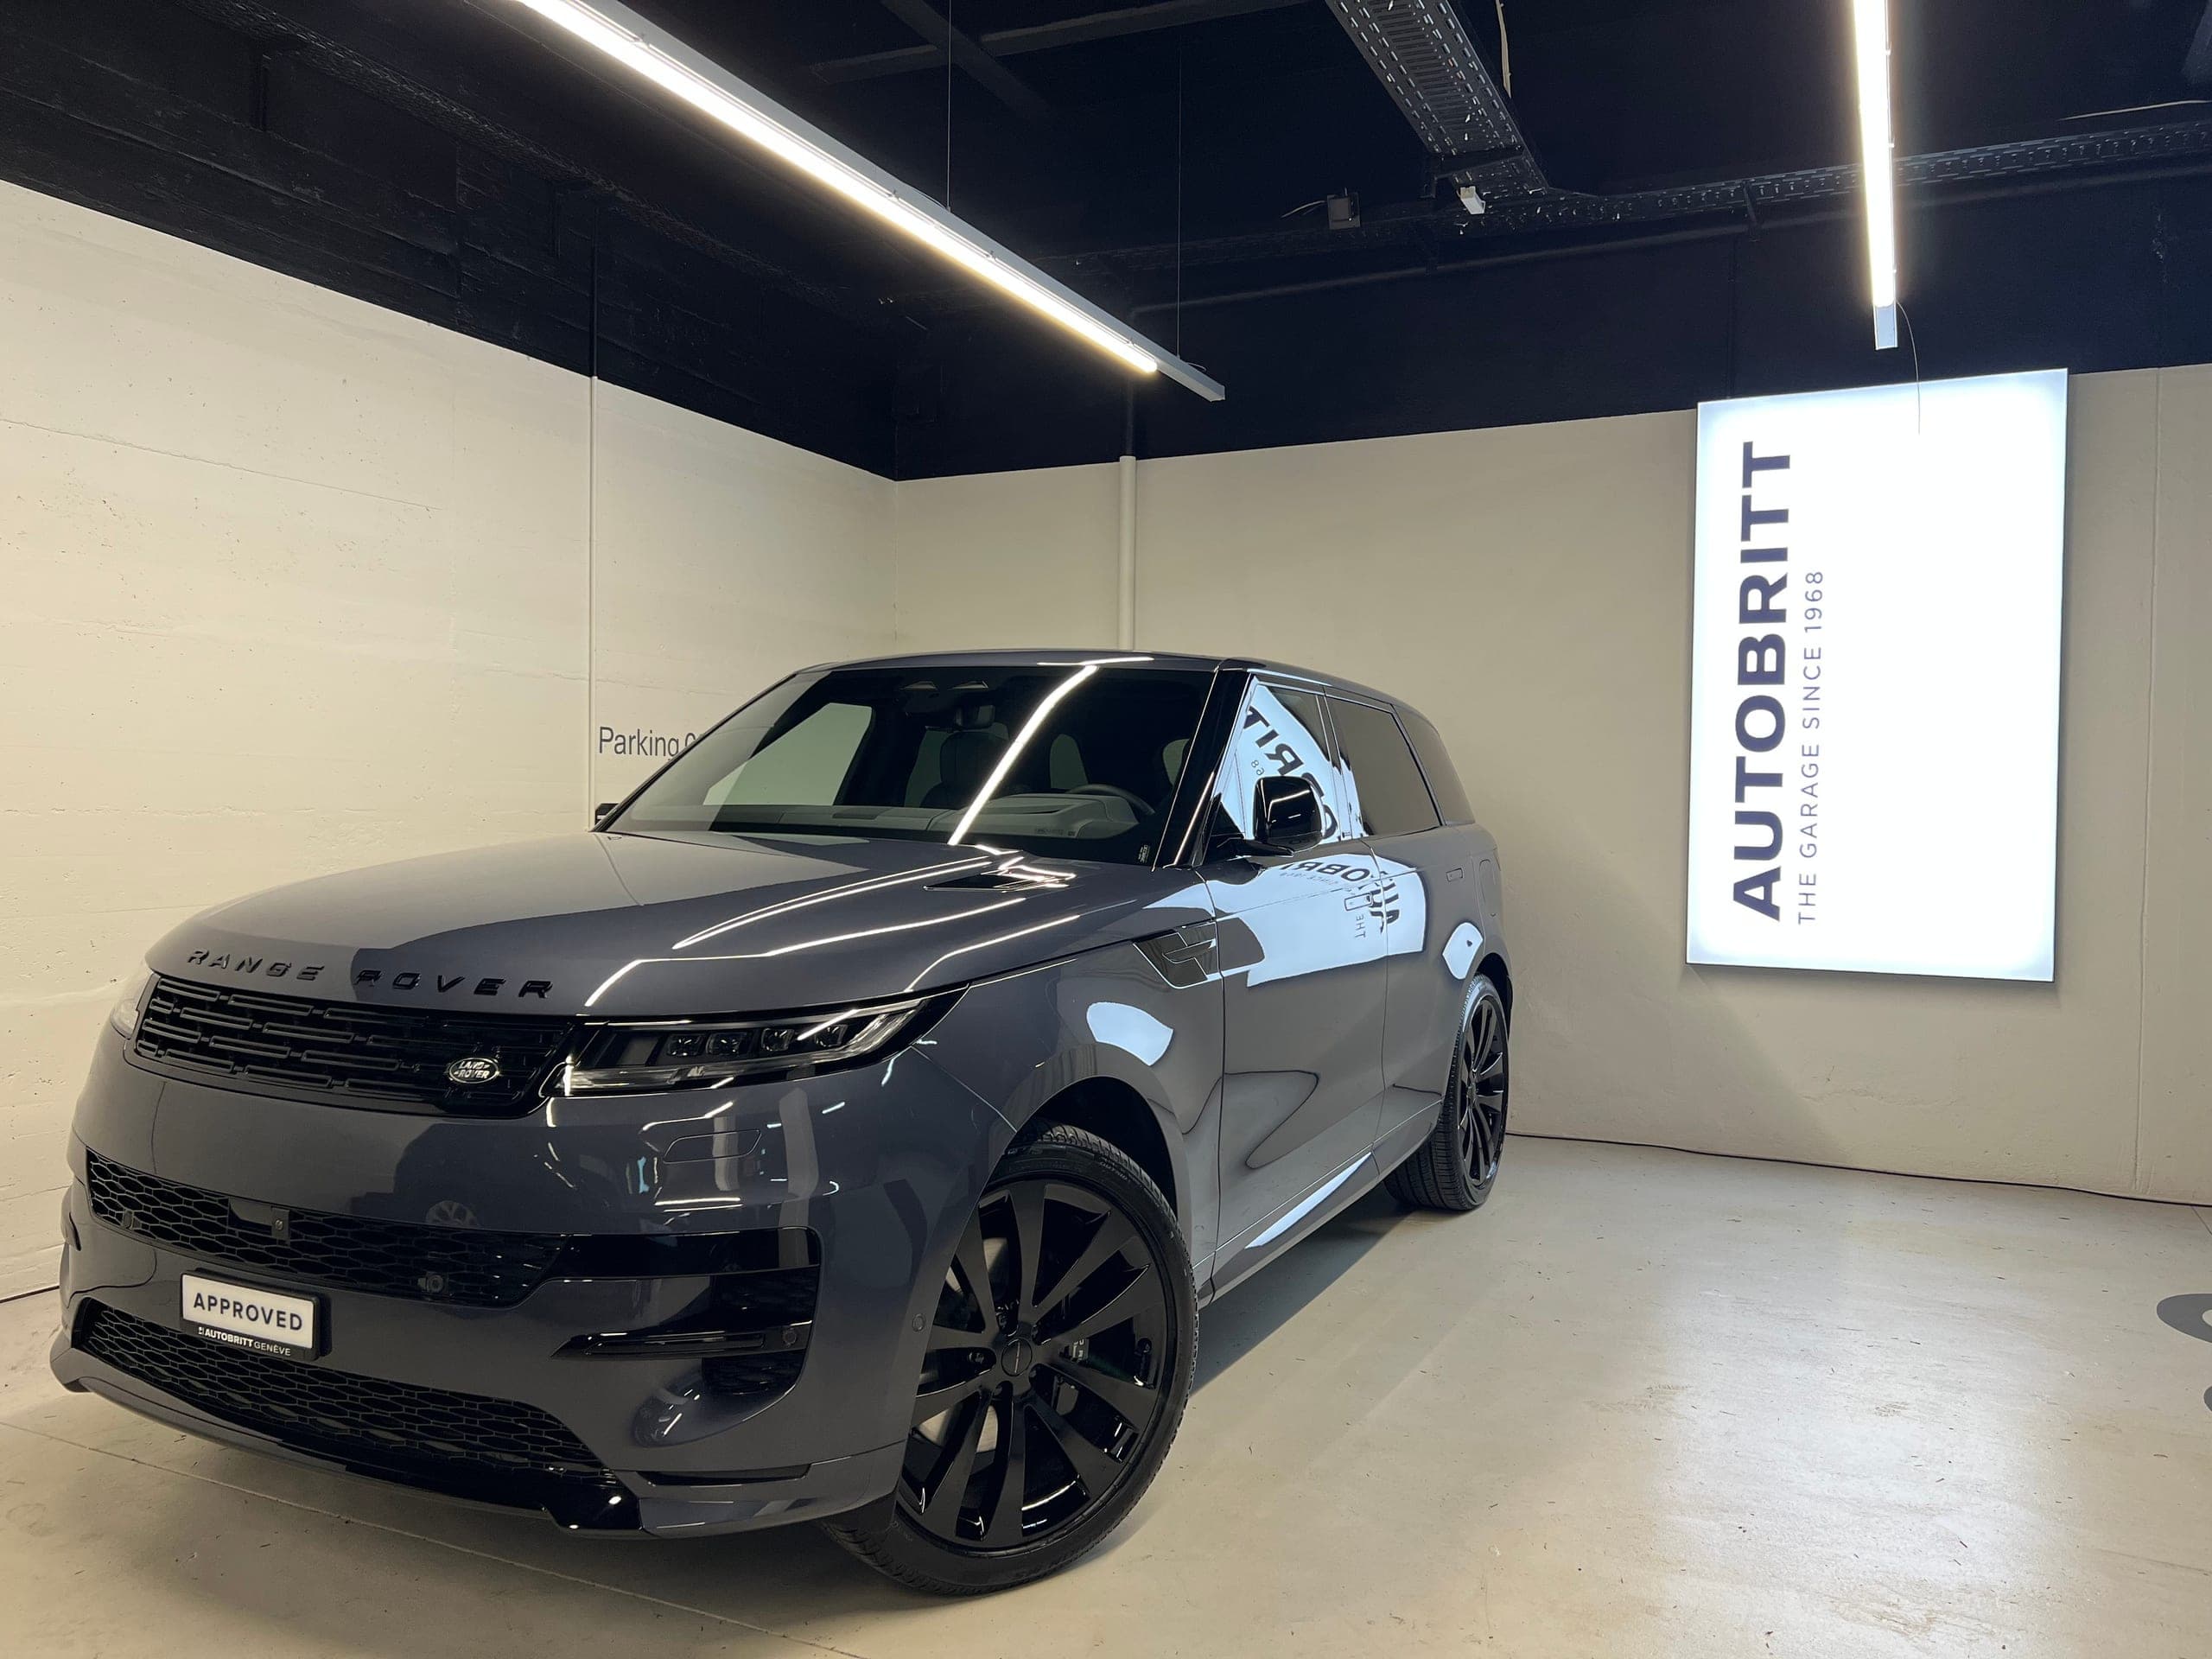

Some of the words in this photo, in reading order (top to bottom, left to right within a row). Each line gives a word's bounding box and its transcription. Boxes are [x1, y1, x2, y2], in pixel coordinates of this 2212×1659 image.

[1803, 570, 1824, 633] 1968
[1732, 441, 1791, 922] AUTOBRITT
[1802, 646, 1822, 729] SINCE
[599, 726, 679, 760] Parking
[1799, 743, 1821, 860] GARAGE
[1797, 873, 1817, 925] THE
[187, 949, 325, 982] RANGE
[355, 969, 554, 1000] ROVER
[458, 1060, 486, 1070] LAND
[458, 1069, 491, 1079] ROVER
[193, 1292, 303, 1332] APPROVED
[204, 1327, 254, 1349] AUTOBRITT
